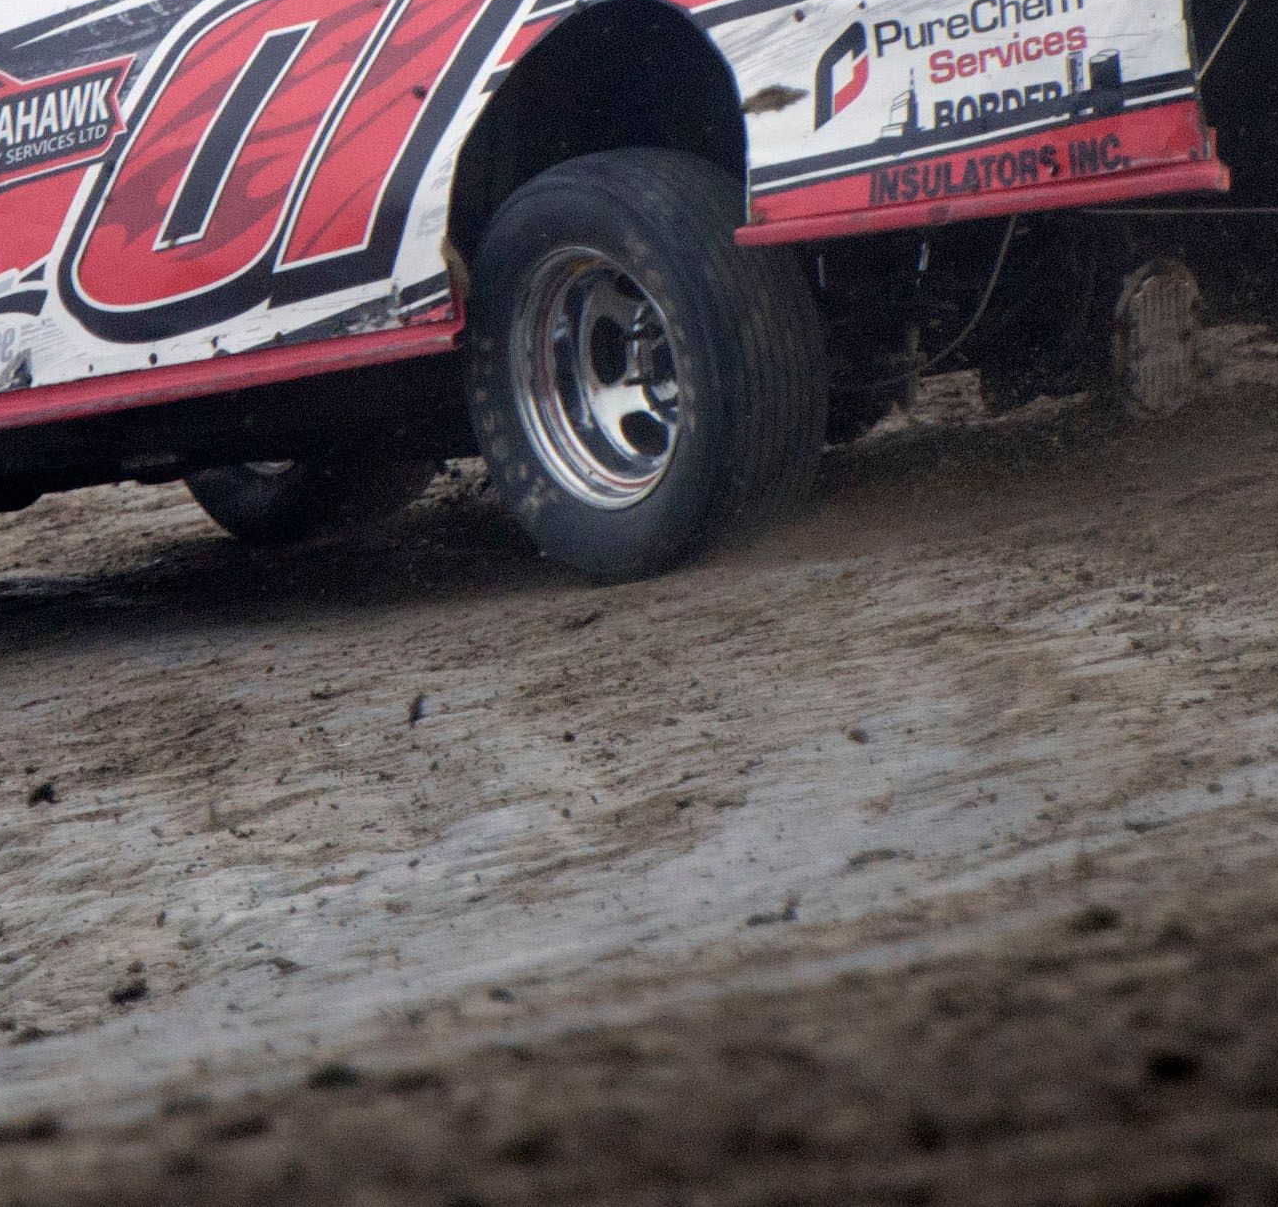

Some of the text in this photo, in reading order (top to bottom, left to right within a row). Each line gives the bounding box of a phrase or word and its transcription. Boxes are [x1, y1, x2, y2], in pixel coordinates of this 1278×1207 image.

[929, 25, 1088, 85] Services
[5, 135, 74, 165] SERVICES
[77, 123, 109, 145] LTD
